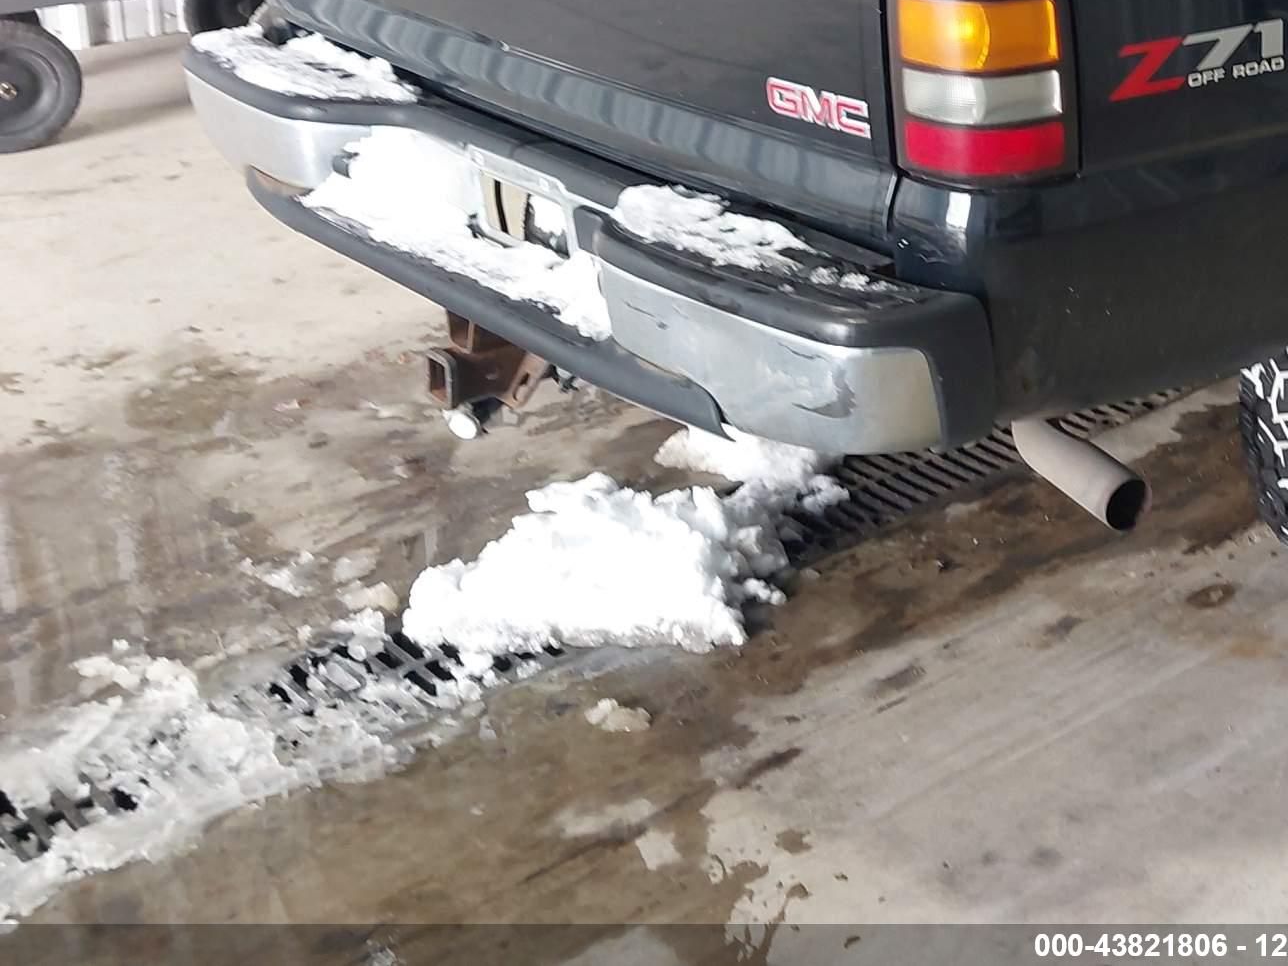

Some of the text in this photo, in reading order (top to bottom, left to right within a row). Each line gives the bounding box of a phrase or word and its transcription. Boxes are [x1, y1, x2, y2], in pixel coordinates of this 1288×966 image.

[1109, 18, 1284, 102] Z71
[1188, 57, 1285, 87] OFF ROAD
[766, 76, 872, 139] GMC
